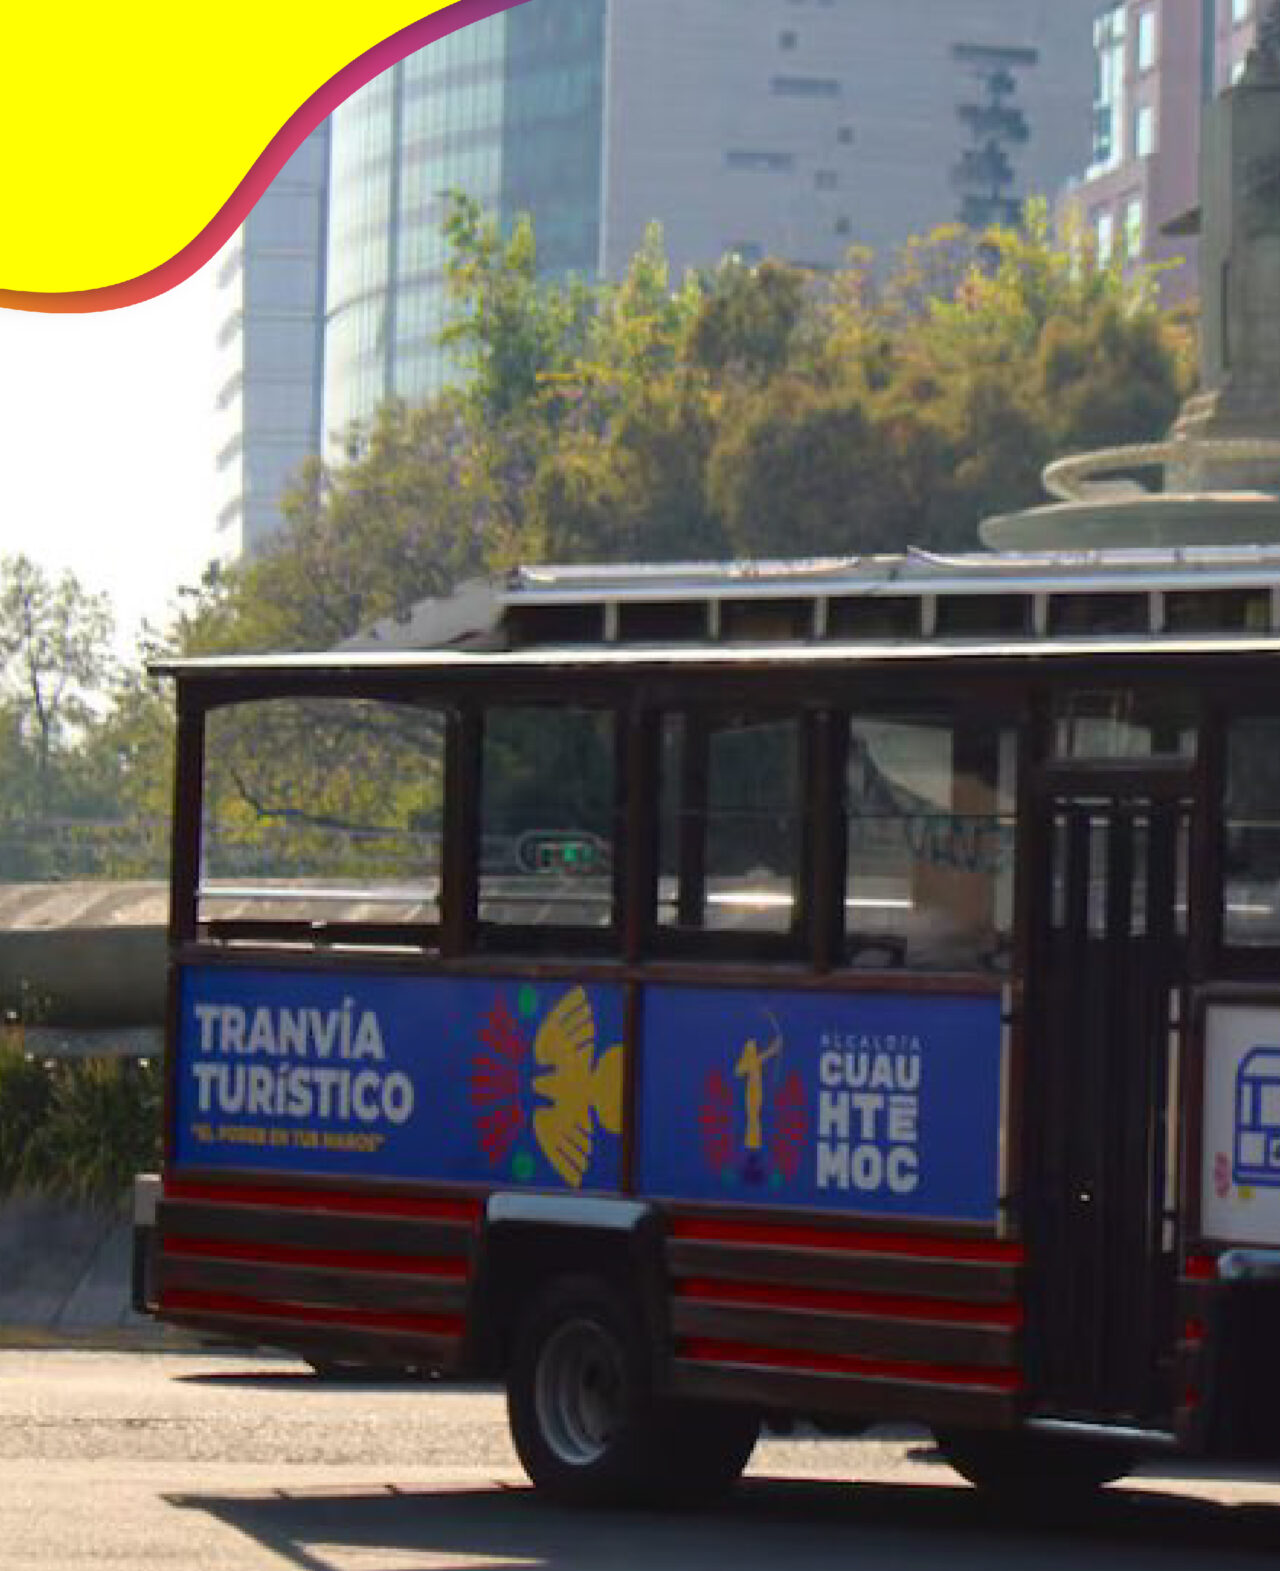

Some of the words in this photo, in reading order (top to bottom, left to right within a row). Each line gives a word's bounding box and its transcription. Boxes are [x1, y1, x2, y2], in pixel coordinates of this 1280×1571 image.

[195, 997, 386, 1060] TRANVÍA
[820, 1052, 921, 1089] CUAU
[817, 1142, 920, 1194] MOC
